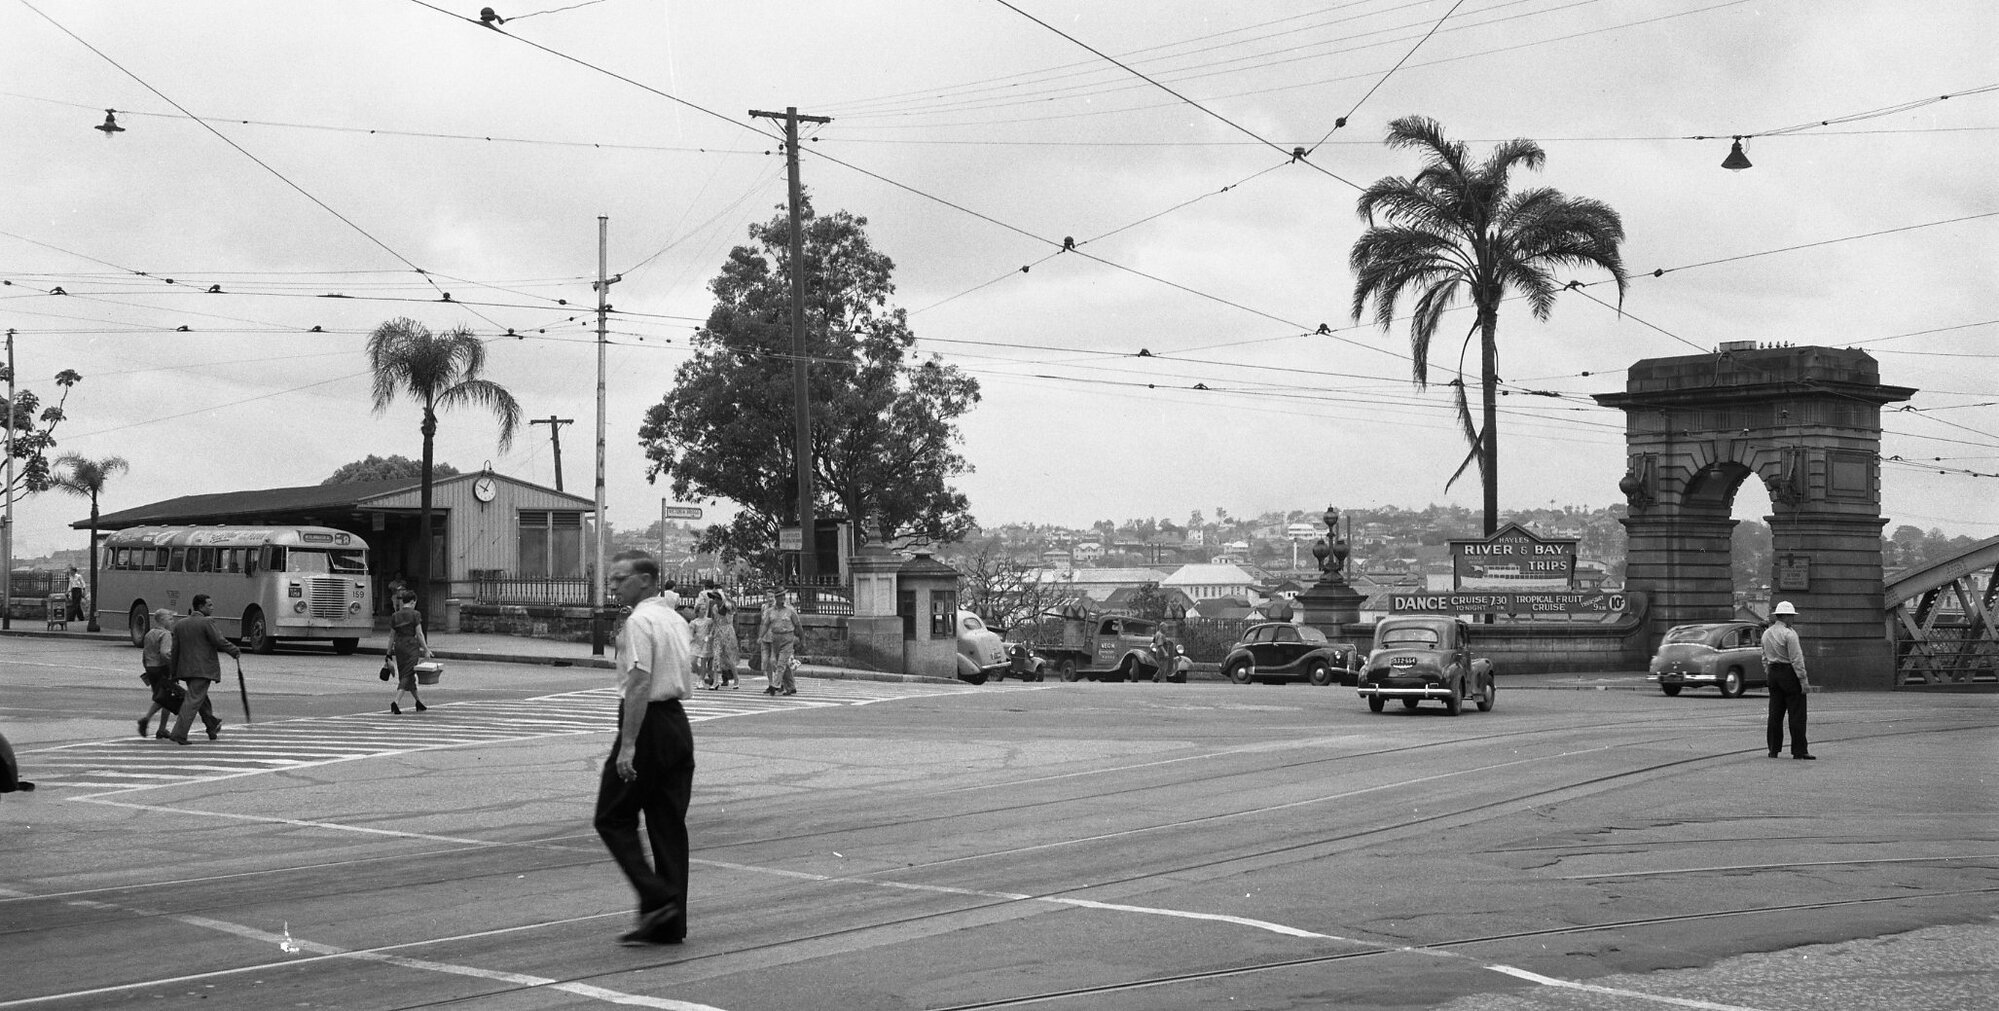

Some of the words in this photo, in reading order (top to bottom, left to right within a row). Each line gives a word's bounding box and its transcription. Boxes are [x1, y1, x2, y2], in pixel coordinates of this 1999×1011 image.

[1464, 544, 1513, 555] RIVER
[1520, 546, 1528, 555] &
[1534, 544, 1564, 555] BAY
[1528, 560, 1567, 571] TRIPS
[352, 590, 365, 599] 159
[1515, 595, 1554, 603] TROPICAL
[1555, 595, 1584, 603] FRUIT
[1394, 596, 1448, 610] DANCE
[1450, 595, 1488, 605] CRUISE
[1532, 603, 1566, 611] CRUISE
[1593, 603, 1599, 611] 9
